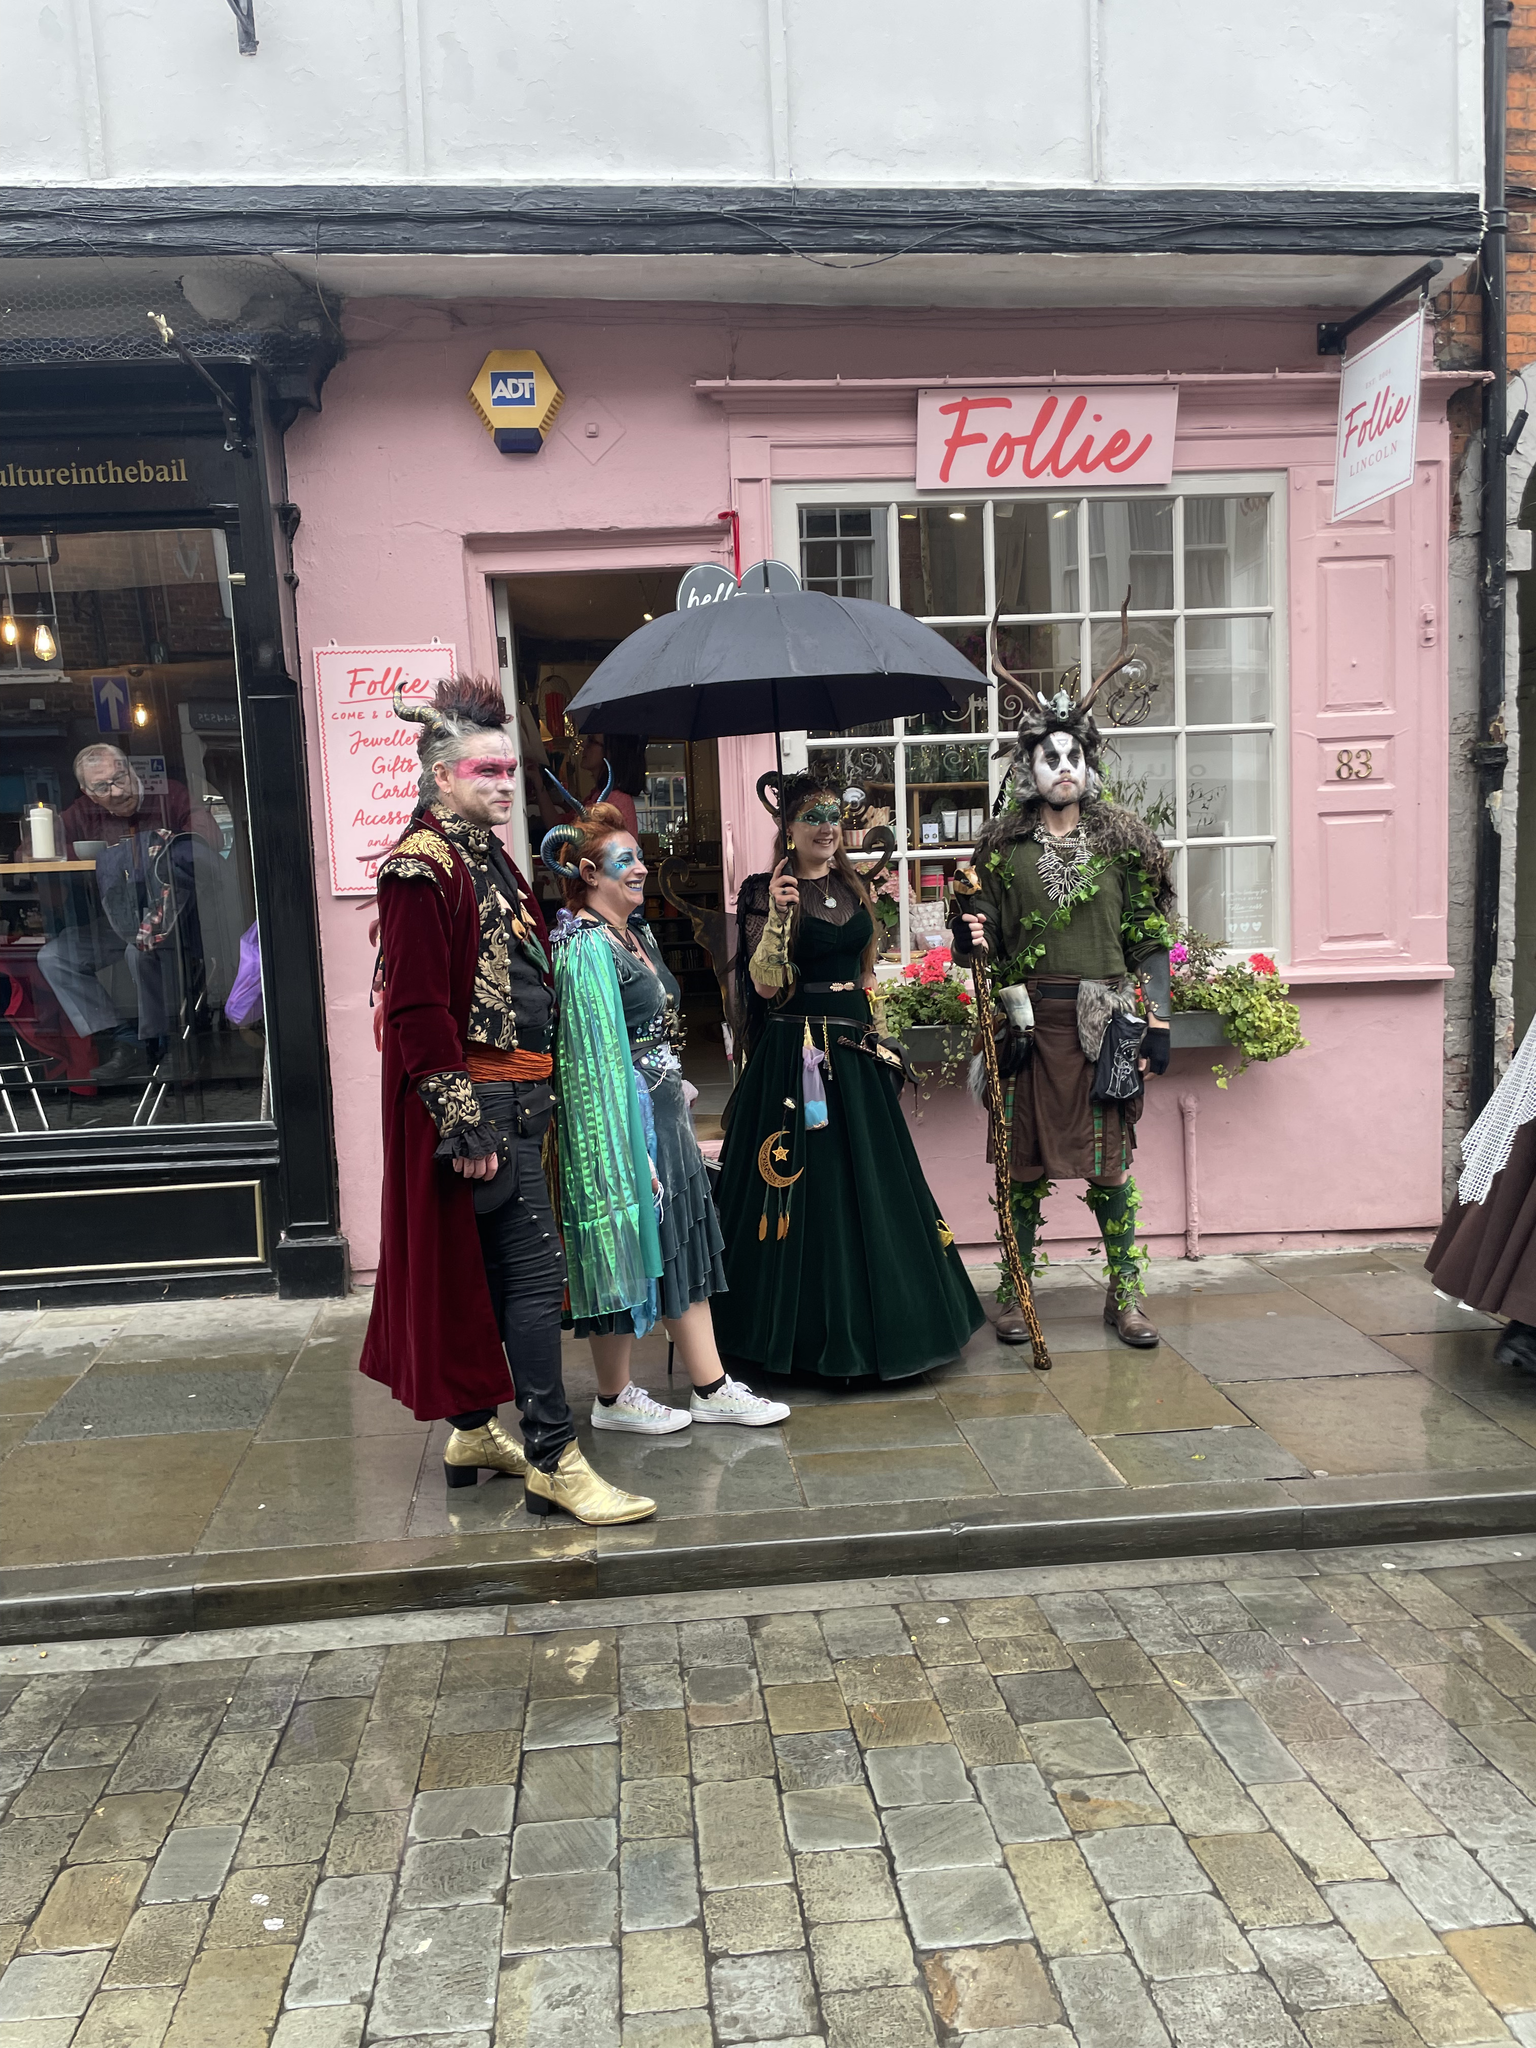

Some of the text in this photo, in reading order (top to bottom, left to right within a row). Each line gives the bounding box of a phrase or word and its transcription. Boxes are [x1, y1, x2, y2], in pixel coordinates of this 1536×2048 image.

[492, 378, 535, 399] ADT
[1343, 385, 1411, 458] Follie
[939, 395, 1153, 483] Follie
[1349, 440, 1398, 477] LINCOLN
[686, 581, 747, 609] hell
[346, 666, 430, 699] Follie
[331, 711, 366, 721] COME
[372, 710, 379, 720] &
[349, 729, 420, 755] Jeweller
[371, 755, 418, 780] Gifts
[1335, 748, 1373, 780] 83
[371, 780, 419, 800] Cards
[352, 808, 413, 828] Accesso
